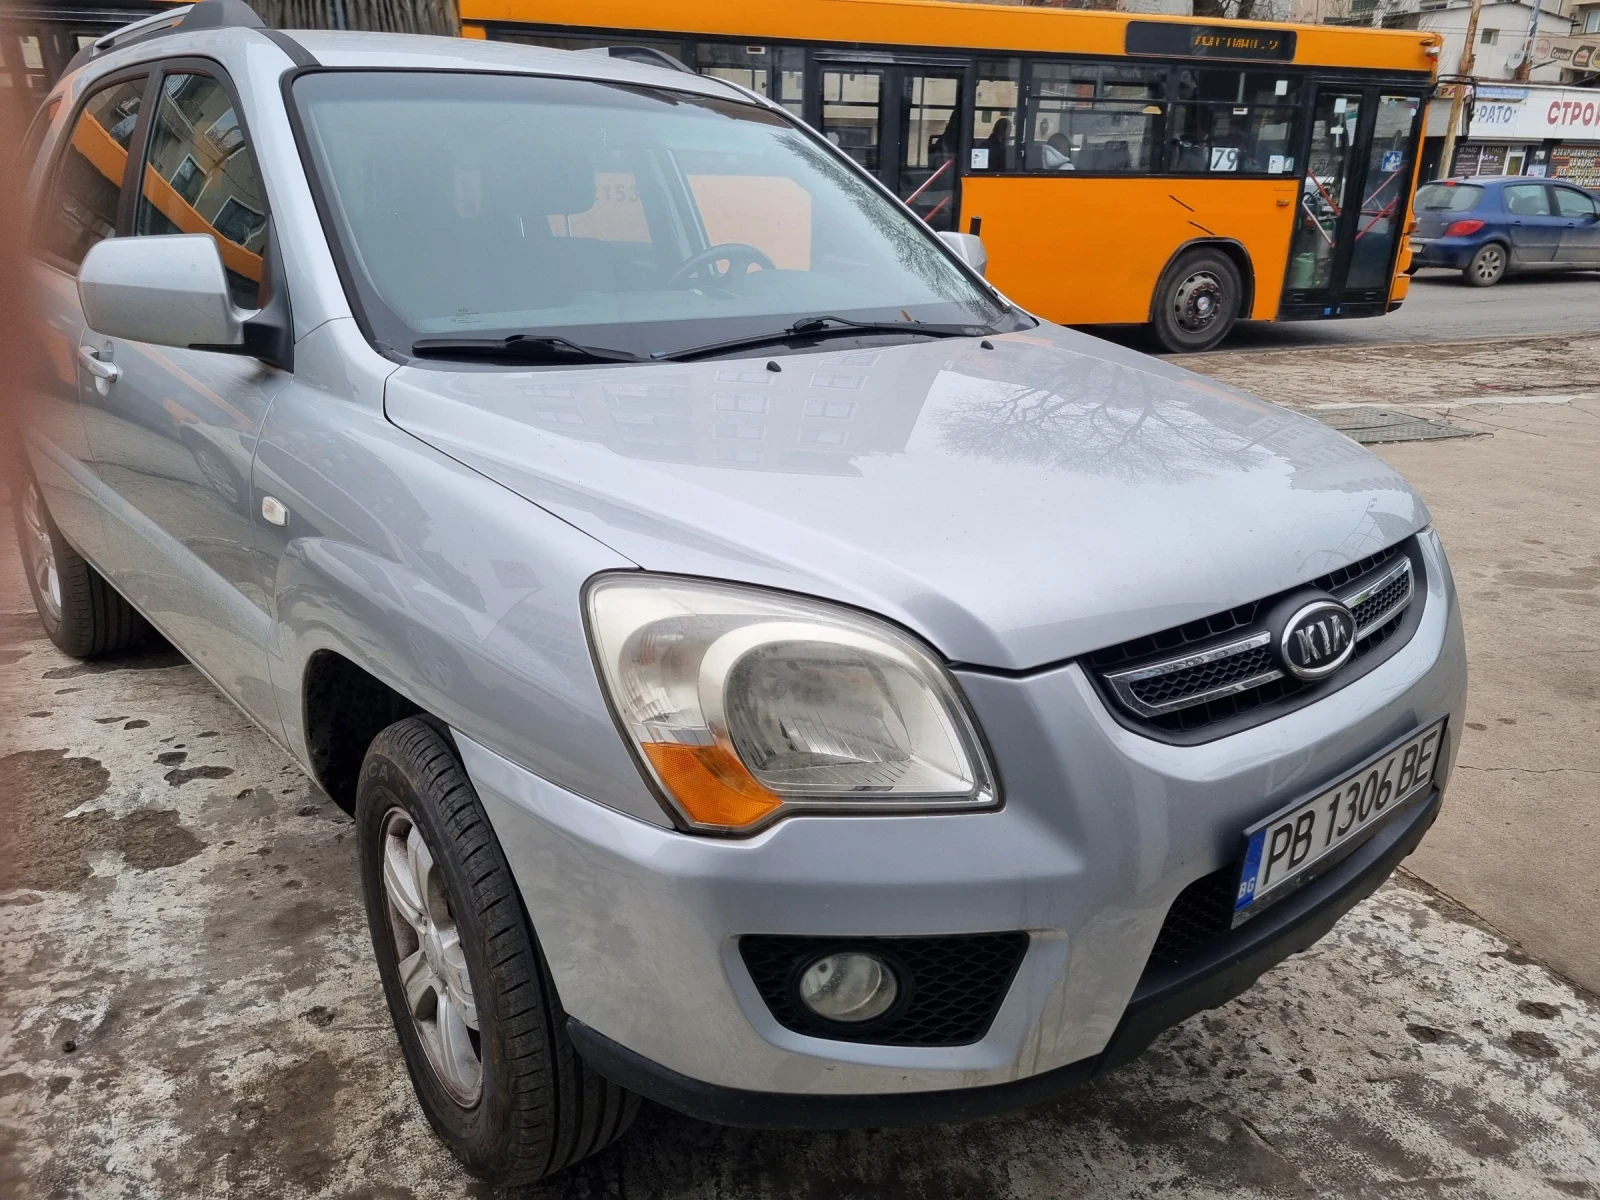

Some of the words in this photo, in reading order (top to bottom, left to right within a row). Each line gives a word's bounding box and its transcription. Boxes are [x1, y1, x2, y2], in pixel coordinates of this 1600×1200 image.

[1214, 149, 1239, 170] 79
[1263, 809, 1316, 887] PB
[1325, 757, 1396, 847] 1306
[1395, 729, 1438, 800] BE
[1238, 877, 1256, 899] BG
